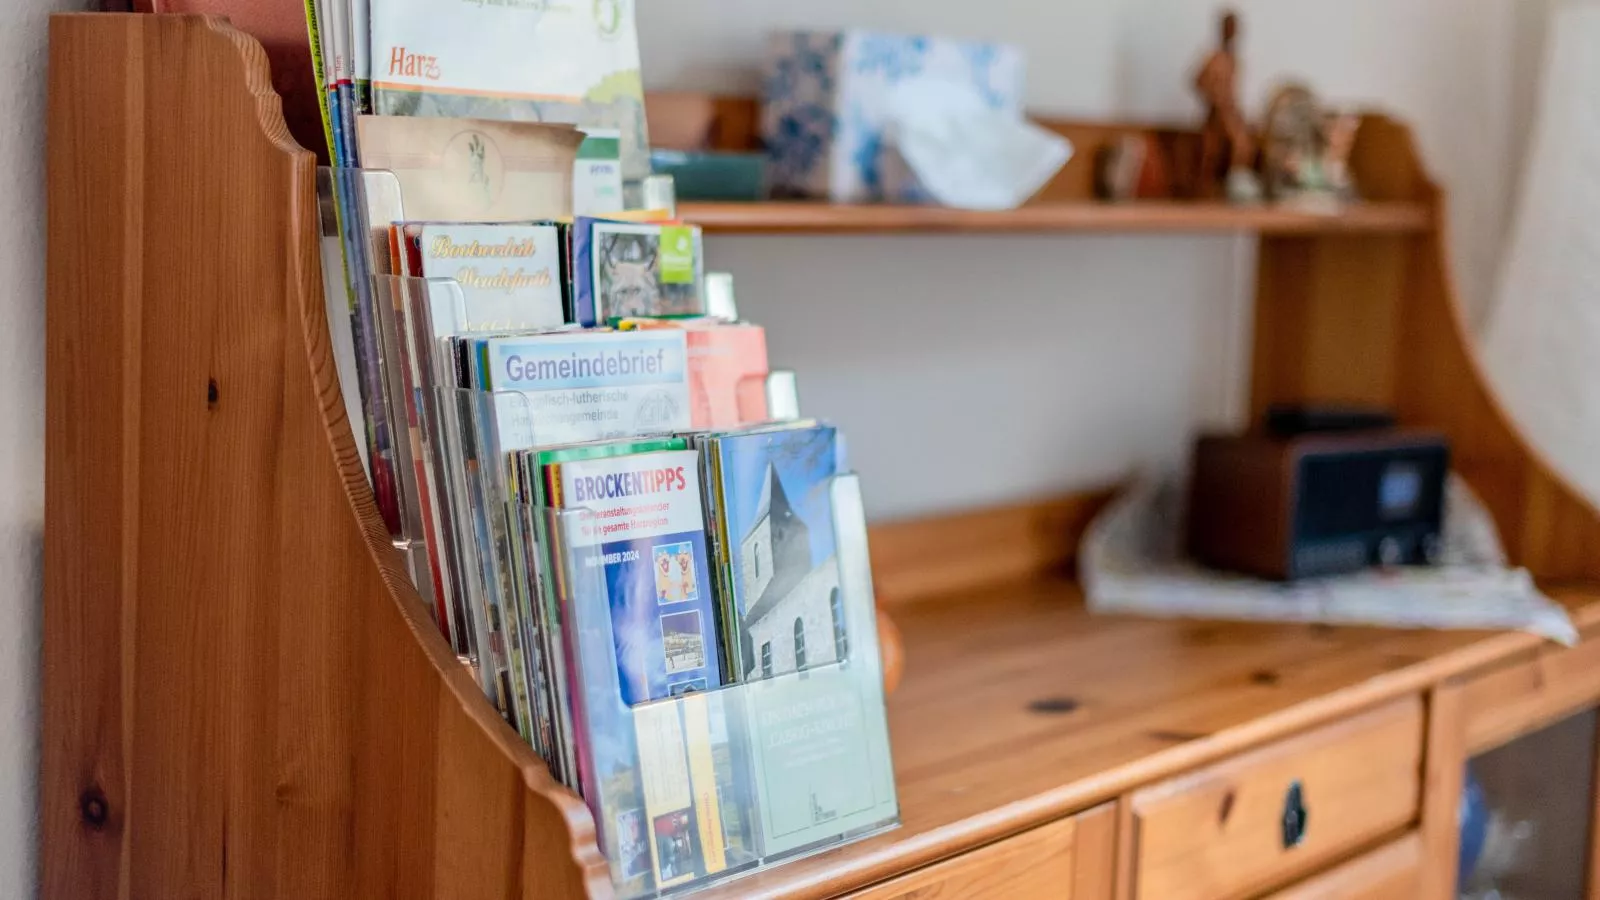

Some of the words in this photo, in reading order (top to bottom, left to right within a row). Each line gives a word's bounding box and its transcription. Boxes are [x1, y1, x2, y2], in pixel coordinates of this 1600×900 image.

[388, 47, 441, 80] Harz
[506, 349, 664, 382] Gemeindebrief
[574, 466, 687, 501] BROCKENTIPPS
[603, 521, 630, 536] gesamte
[622, 550, 640, 562] 2024
